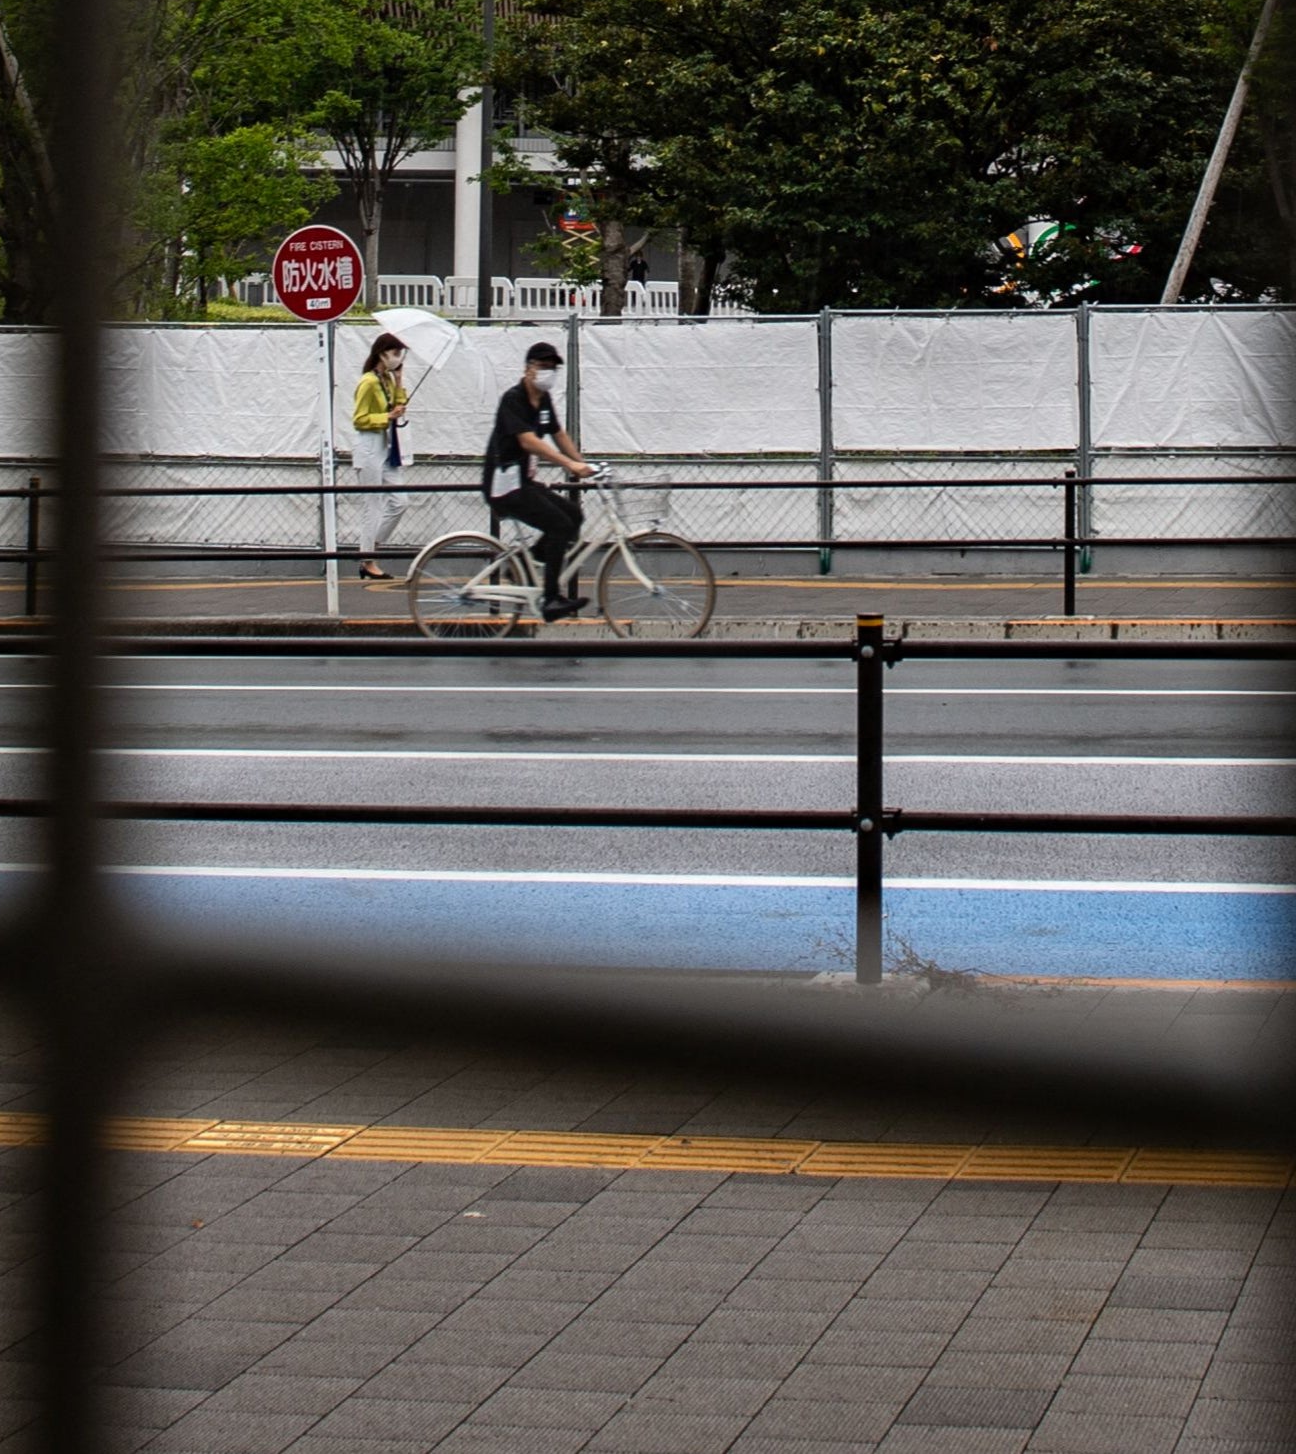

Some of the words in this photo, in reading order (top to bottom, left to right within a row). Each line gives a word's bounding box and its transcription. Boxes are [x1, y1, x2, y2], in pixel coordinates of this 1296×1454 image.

[290, 242, 307, 251] FIRE
[310, 240, 344, 251] CISTERN
[283, 257, 354, 293] 防火水槽
